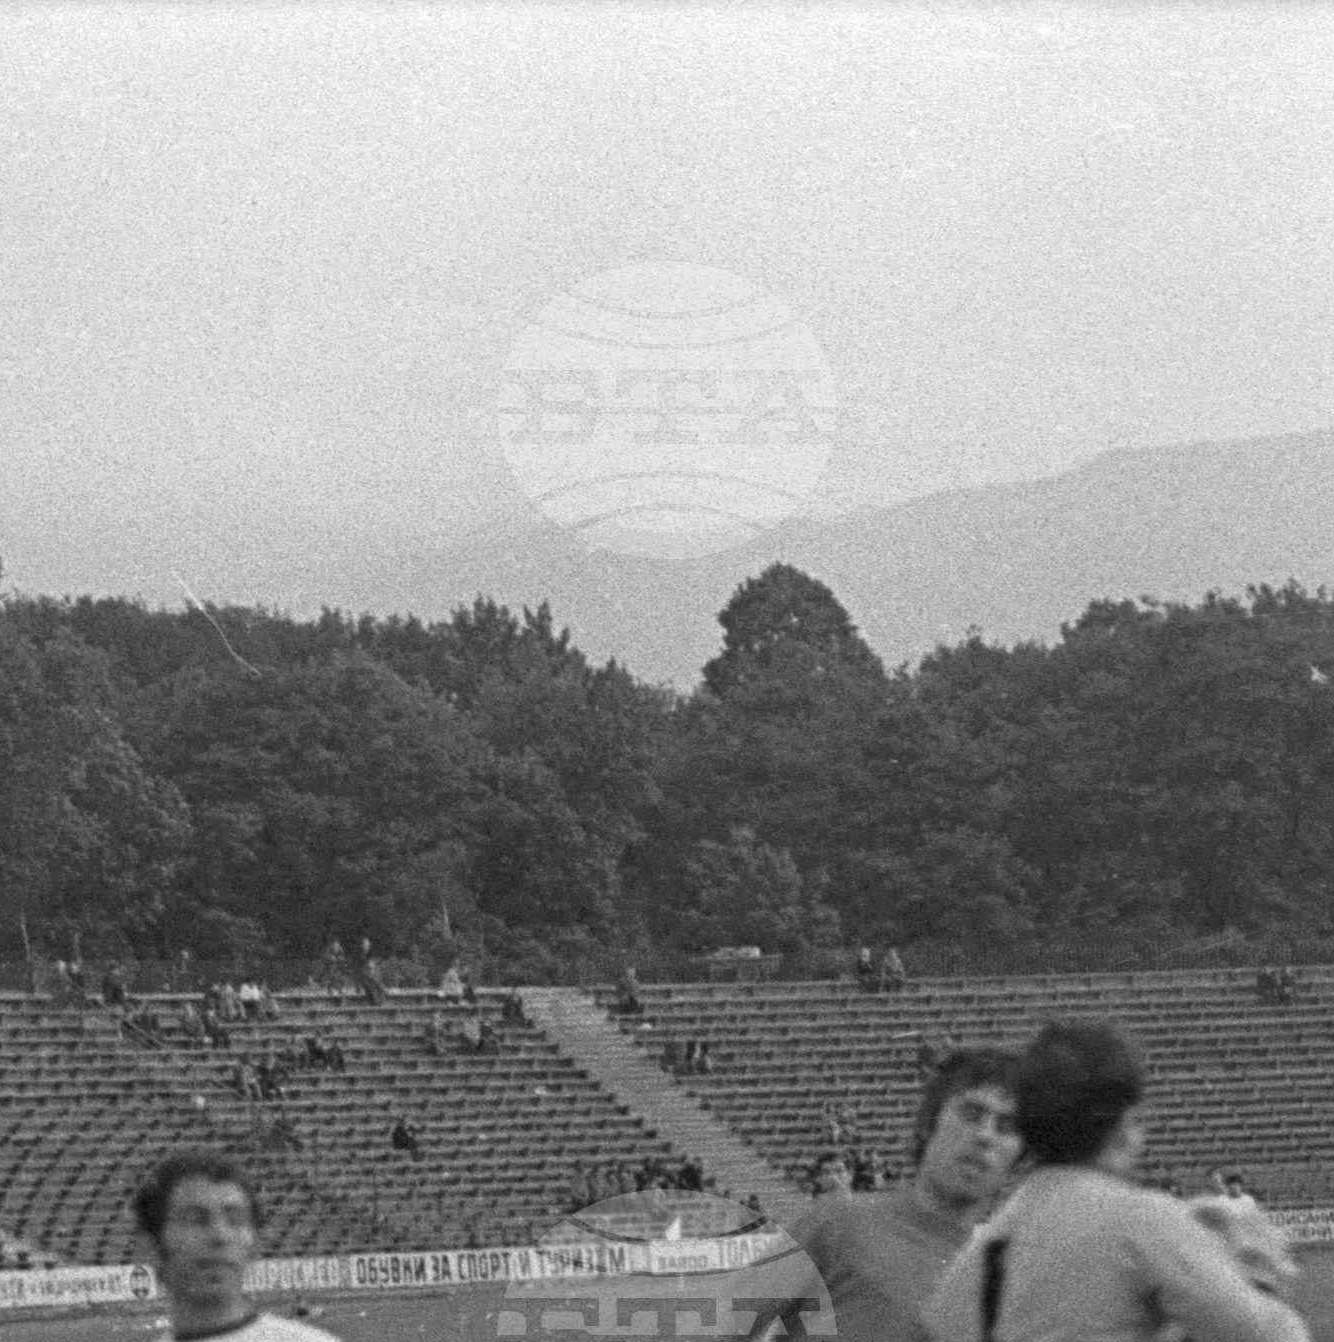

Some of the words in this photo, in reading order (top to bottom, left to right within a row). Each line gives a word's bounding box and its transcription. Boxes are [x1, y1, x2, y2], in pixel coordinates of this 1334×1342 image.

[354, 1253, 428, 1286] ОБУВКИ
[431, 1252, 453, 1282] ЗА
[457, 1249, 513, 1282] СПОРТ
